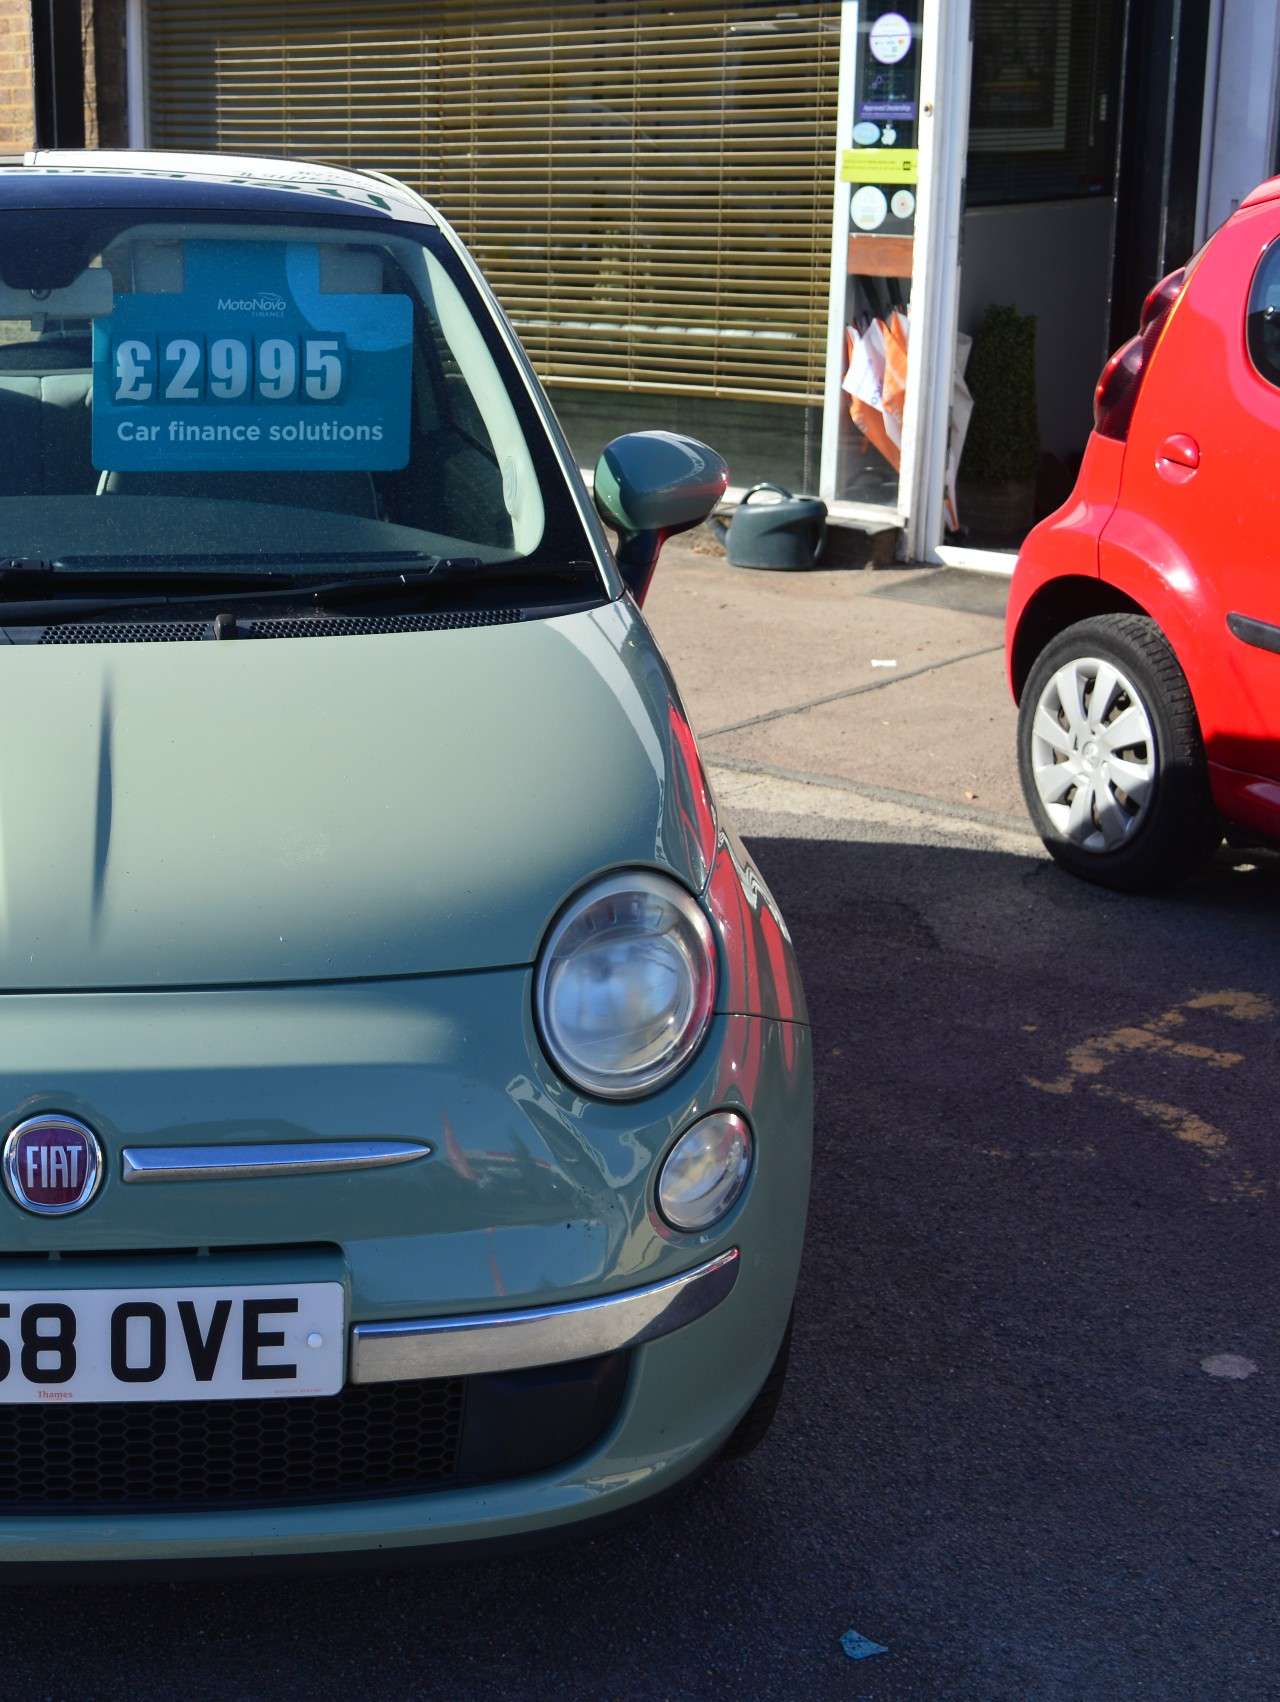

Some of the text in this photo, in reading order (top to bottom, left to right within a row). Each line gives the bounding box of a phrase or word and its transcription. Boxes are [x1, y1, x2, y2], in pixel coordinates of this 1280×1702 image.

[216, 298, 287, 311] MotoNovo
[115, 339, 342, 401] £2995
[117, 420, 384, 441] Car finance solutions
[25, 1144, 84, 1189] FIAT
[110, 1297, 299, 1384] OVE
